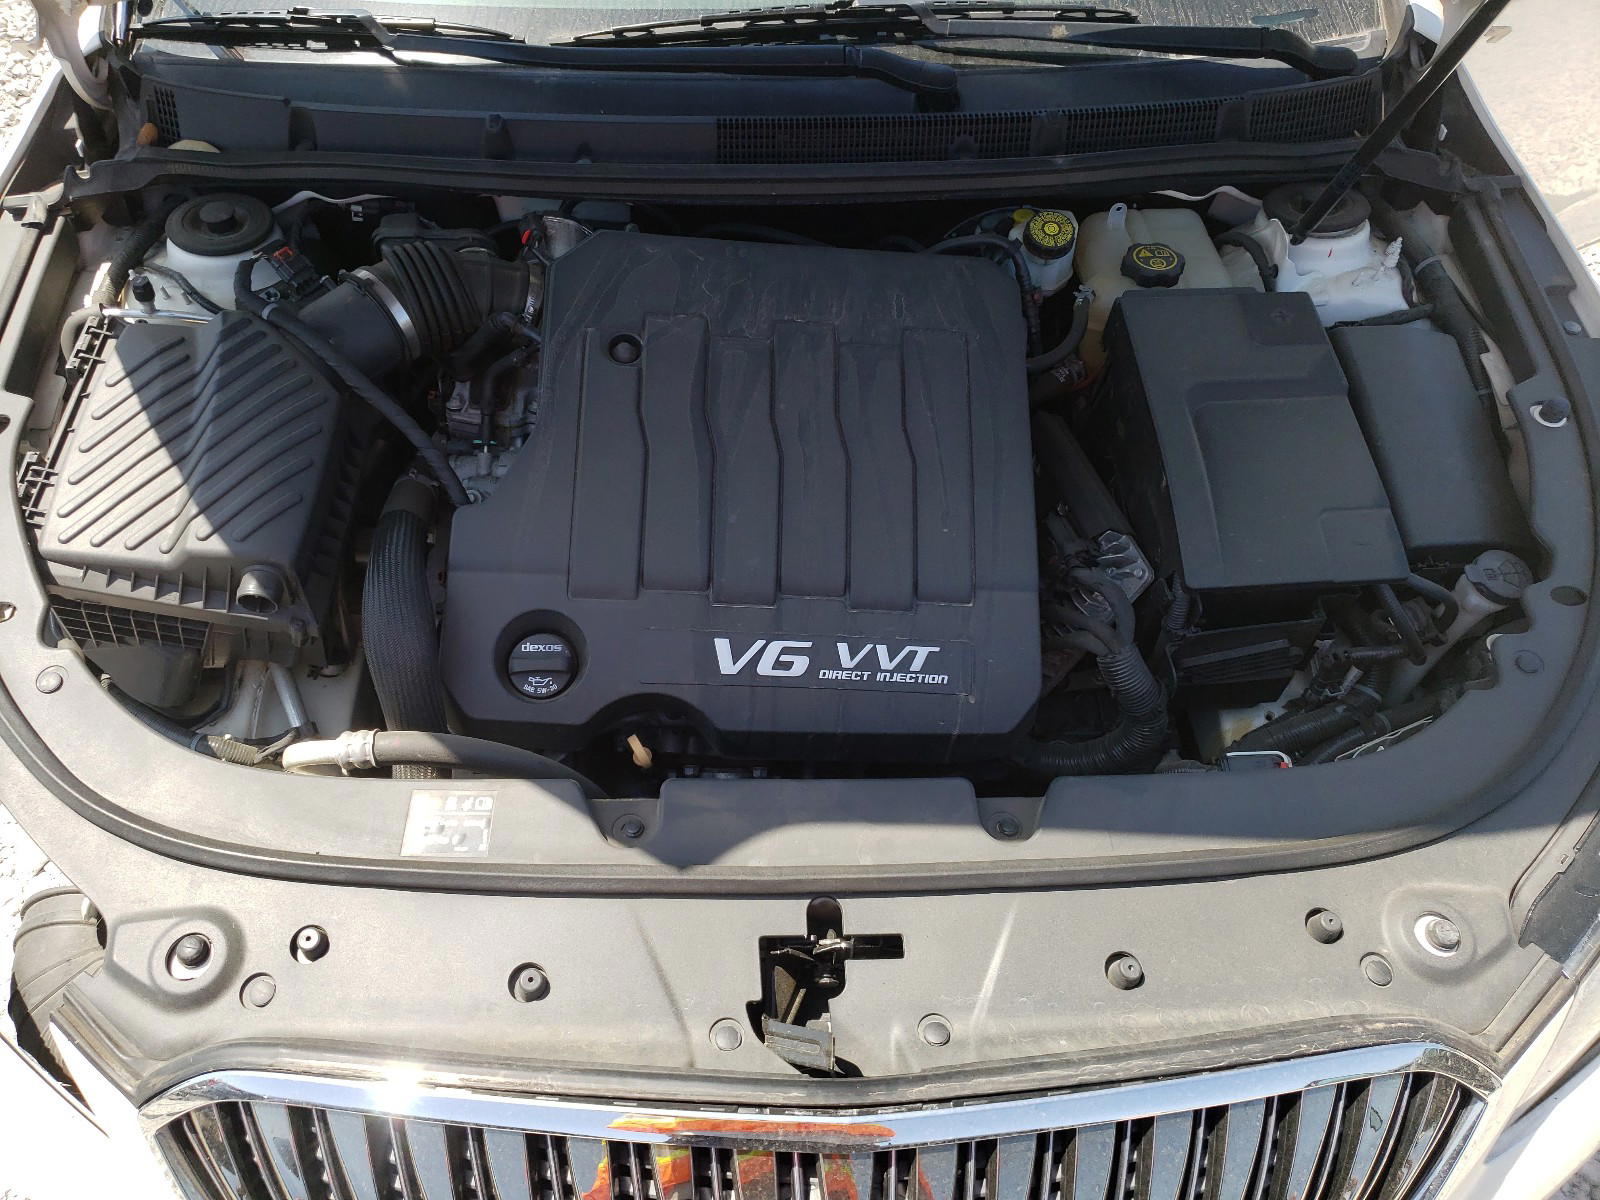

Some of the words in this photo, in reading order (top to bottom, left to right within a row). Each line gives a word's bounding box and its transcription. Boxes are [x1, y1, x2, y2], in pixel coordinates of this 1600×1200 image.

[521, 642, 564, 652] dexos
[713, 638, 813, 677] V6
[836, 642, 941, 672] VVT
[818, 669, 872, 681] DIRECT
[876, 672, 949, 685] INJECTION
[523, 683, 536, 693] SAE
